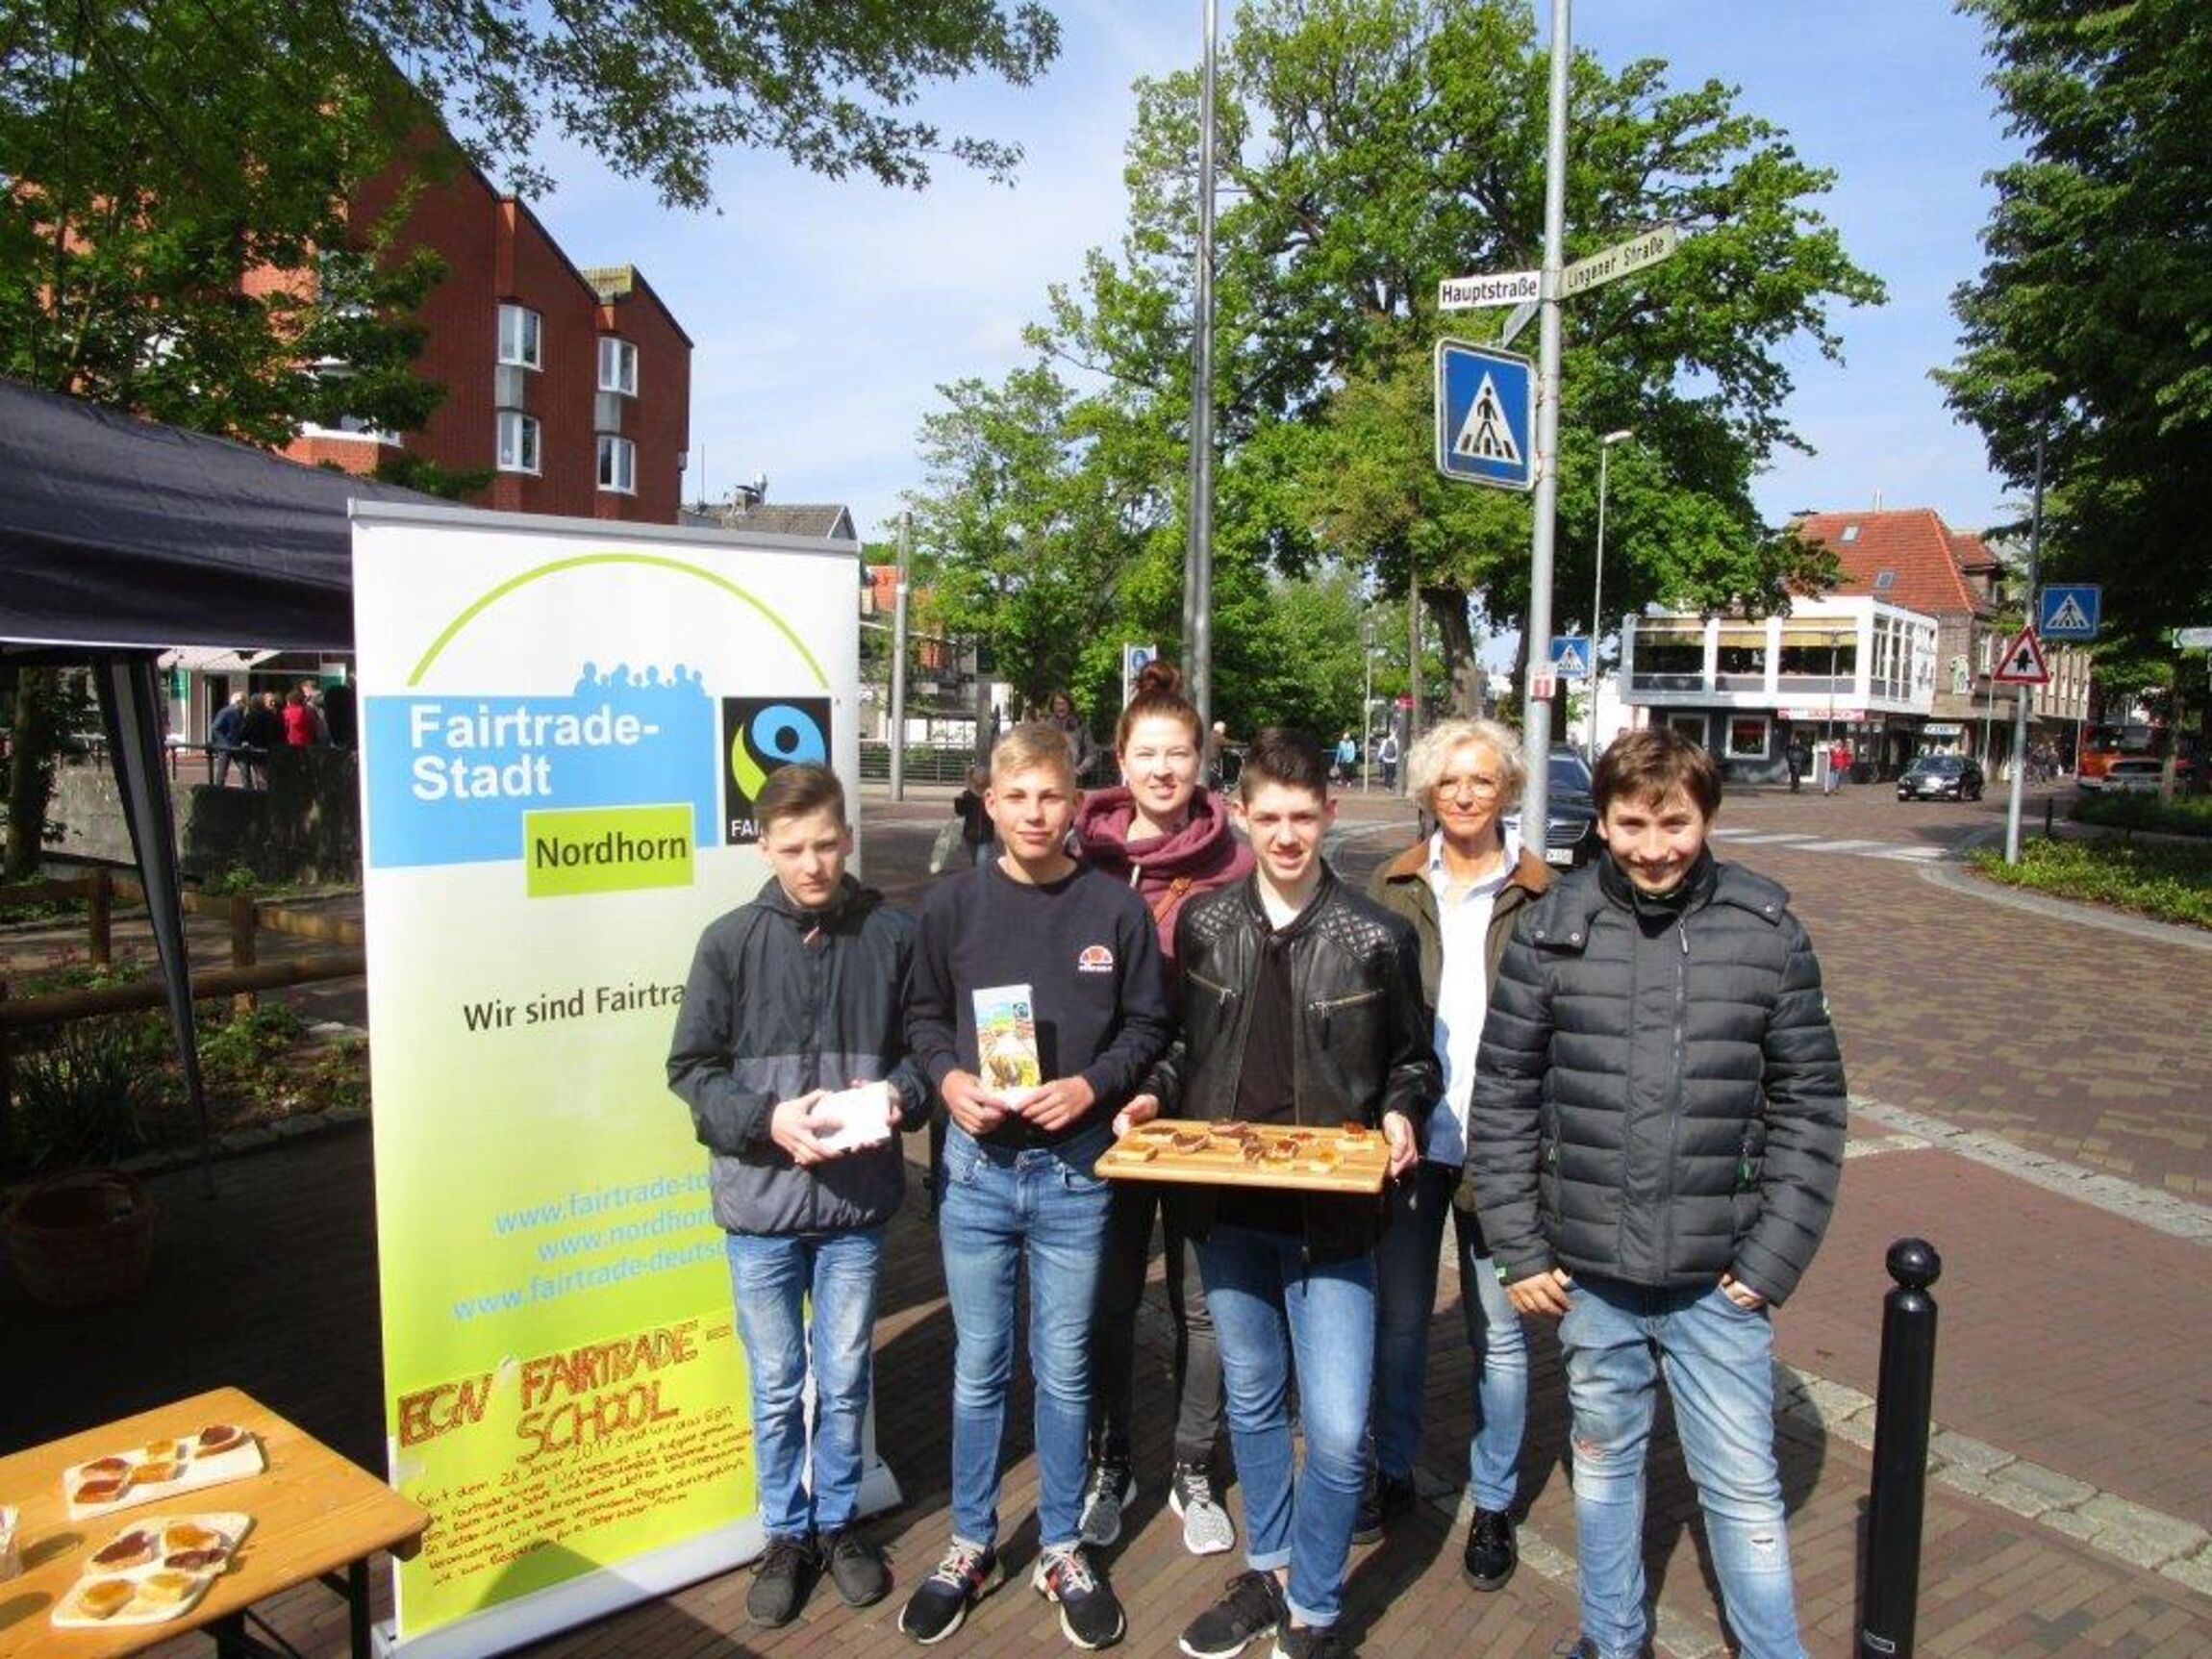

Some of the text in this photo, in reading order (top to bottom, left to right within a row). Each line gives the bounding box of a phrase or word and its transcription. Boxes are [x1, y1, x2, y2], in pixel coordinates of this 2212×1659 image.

[1568, 238, 1665, 289] Lingener Straße
[1443, 278, 1538, 305] Hauptstraße
[409, 704, 660, 749] Fairtrade-
[412, 755, 552, 800] Stadt
[536, 830, 687, 869] Nordhorn
[731, 818, 760, 838] FAI
[464, 982, 686, 1032] Wir sind Fairtra
[494, 1172, 713, 1236] www.fairtrade-to
[516, 1380, 679, 1464] SCHOOL
